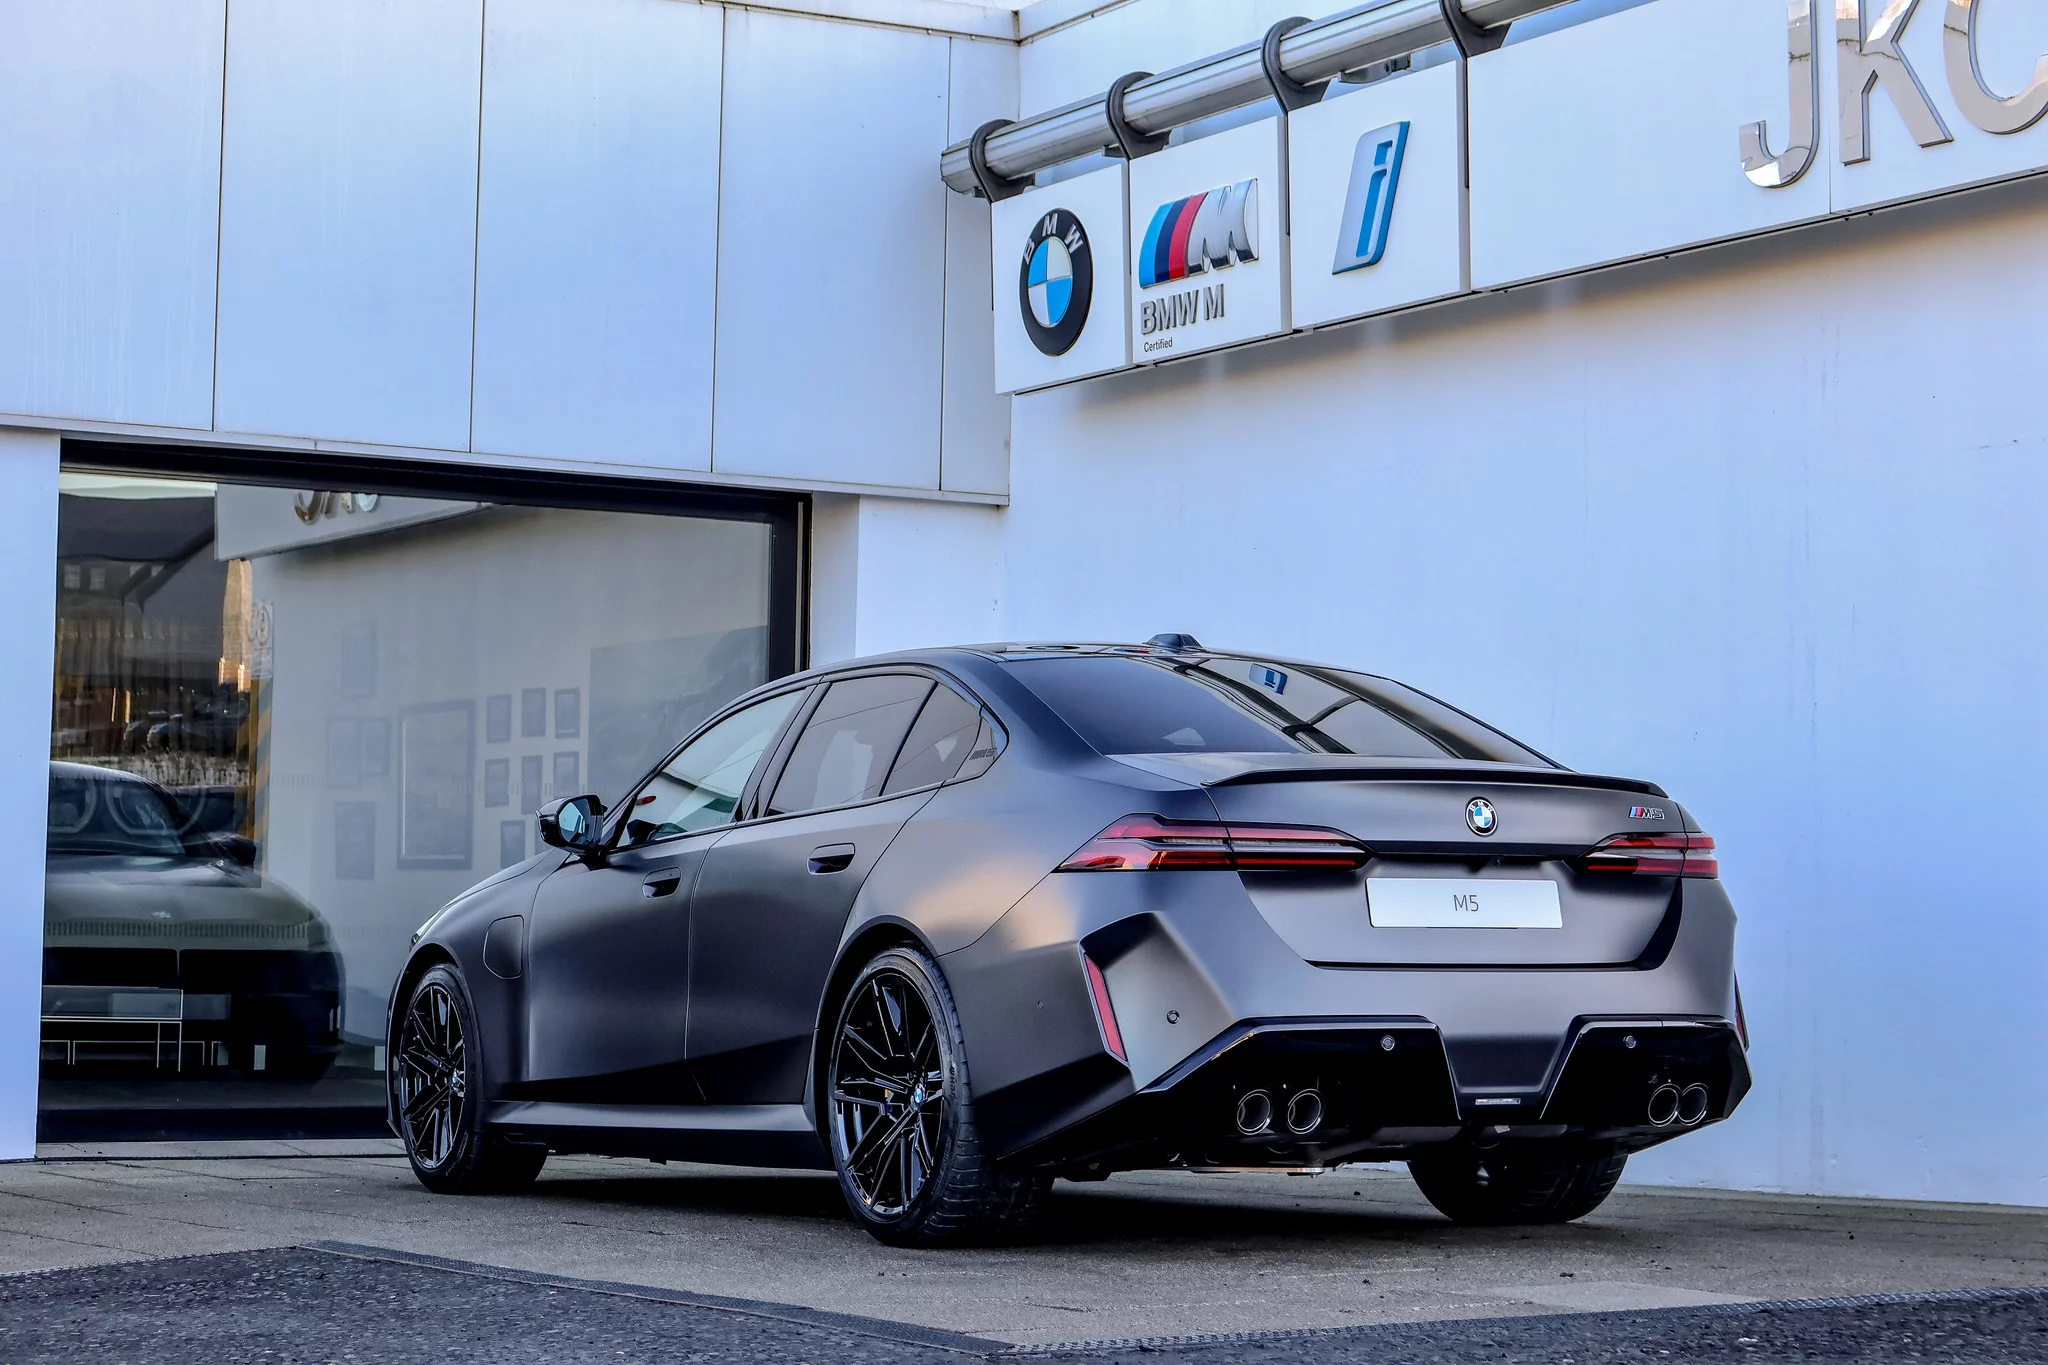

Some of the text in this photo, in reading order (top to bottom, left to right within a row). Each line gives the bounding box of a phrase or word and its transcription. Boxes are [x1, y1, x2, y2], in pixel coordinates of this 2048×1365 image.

[1023, 212, 1084, 265] BMW
[1141, 283, 1224, 335] BMW M
[1144, 337, 1173, 353] Certified
[1642, 806, 1665, 820] M5
[1453, 894, 1479, 912] M5
